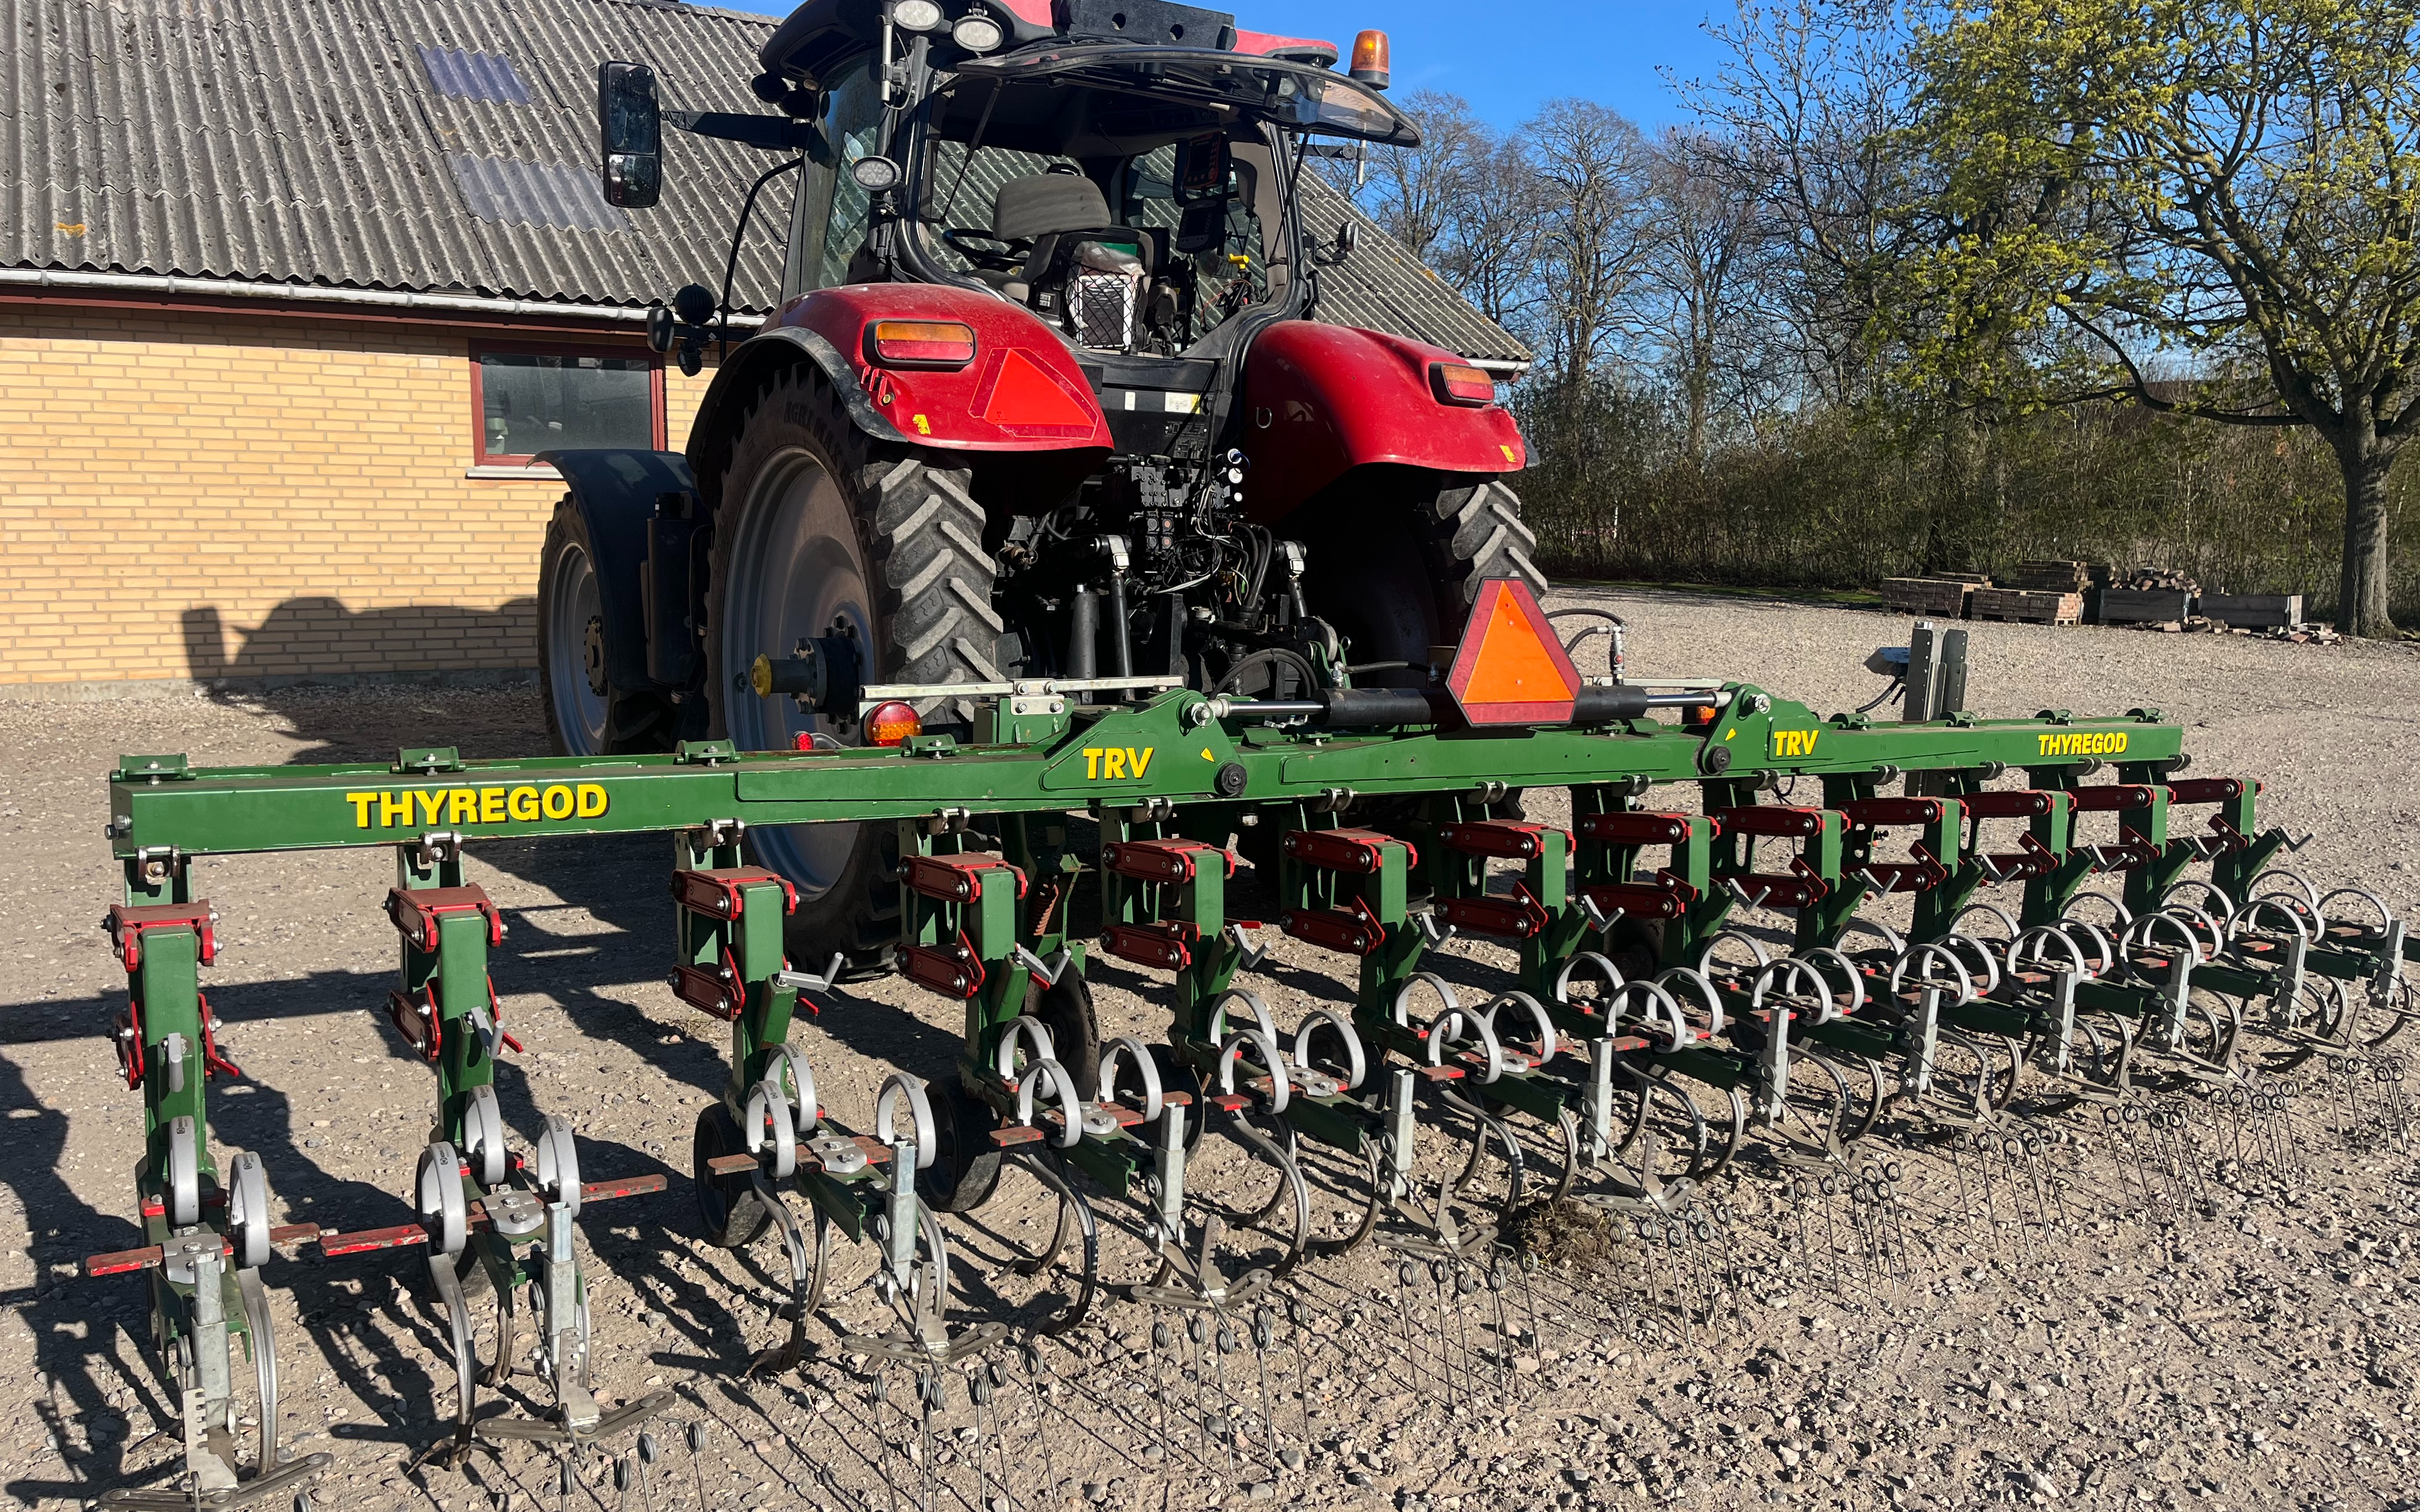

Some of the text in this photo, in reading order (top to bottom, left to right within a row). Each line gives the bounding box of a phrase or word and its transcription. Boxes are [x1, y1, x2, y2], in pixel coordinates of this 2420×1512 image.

[1774, 730, 1820, 756] TRV
[2038, 733, 2129, 756] THYREGOD
[1082, 747, 1154, 779] TRV
[346, 784, 609, 828] THYREGOD
